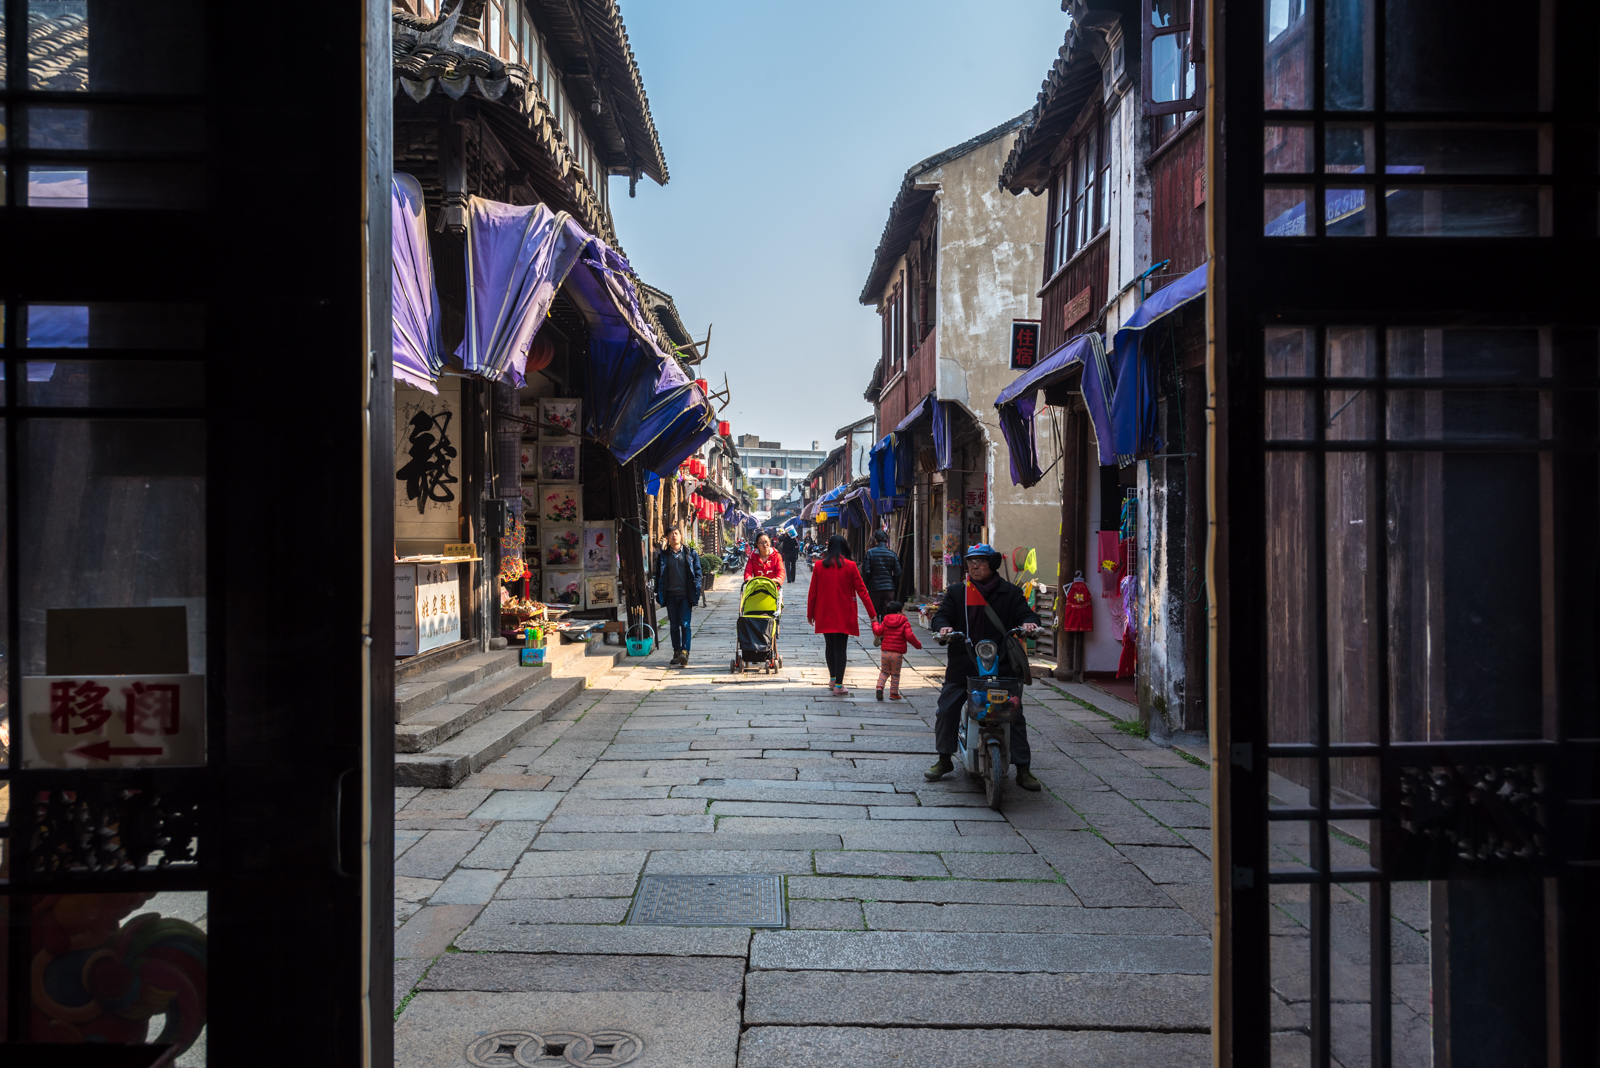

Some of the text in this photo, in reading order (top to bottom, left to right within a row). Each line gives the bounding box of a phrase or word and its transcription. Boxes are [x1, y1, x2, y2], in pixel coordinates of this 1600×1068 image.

[1325, 190, 1366, 220] 62504
[1016, 328, 1034, 366] 住宿
[966, 491, 986, 505] 香烟
[395, 574, 411, 582] raphy
[50, 680, 180, 735] 移门
